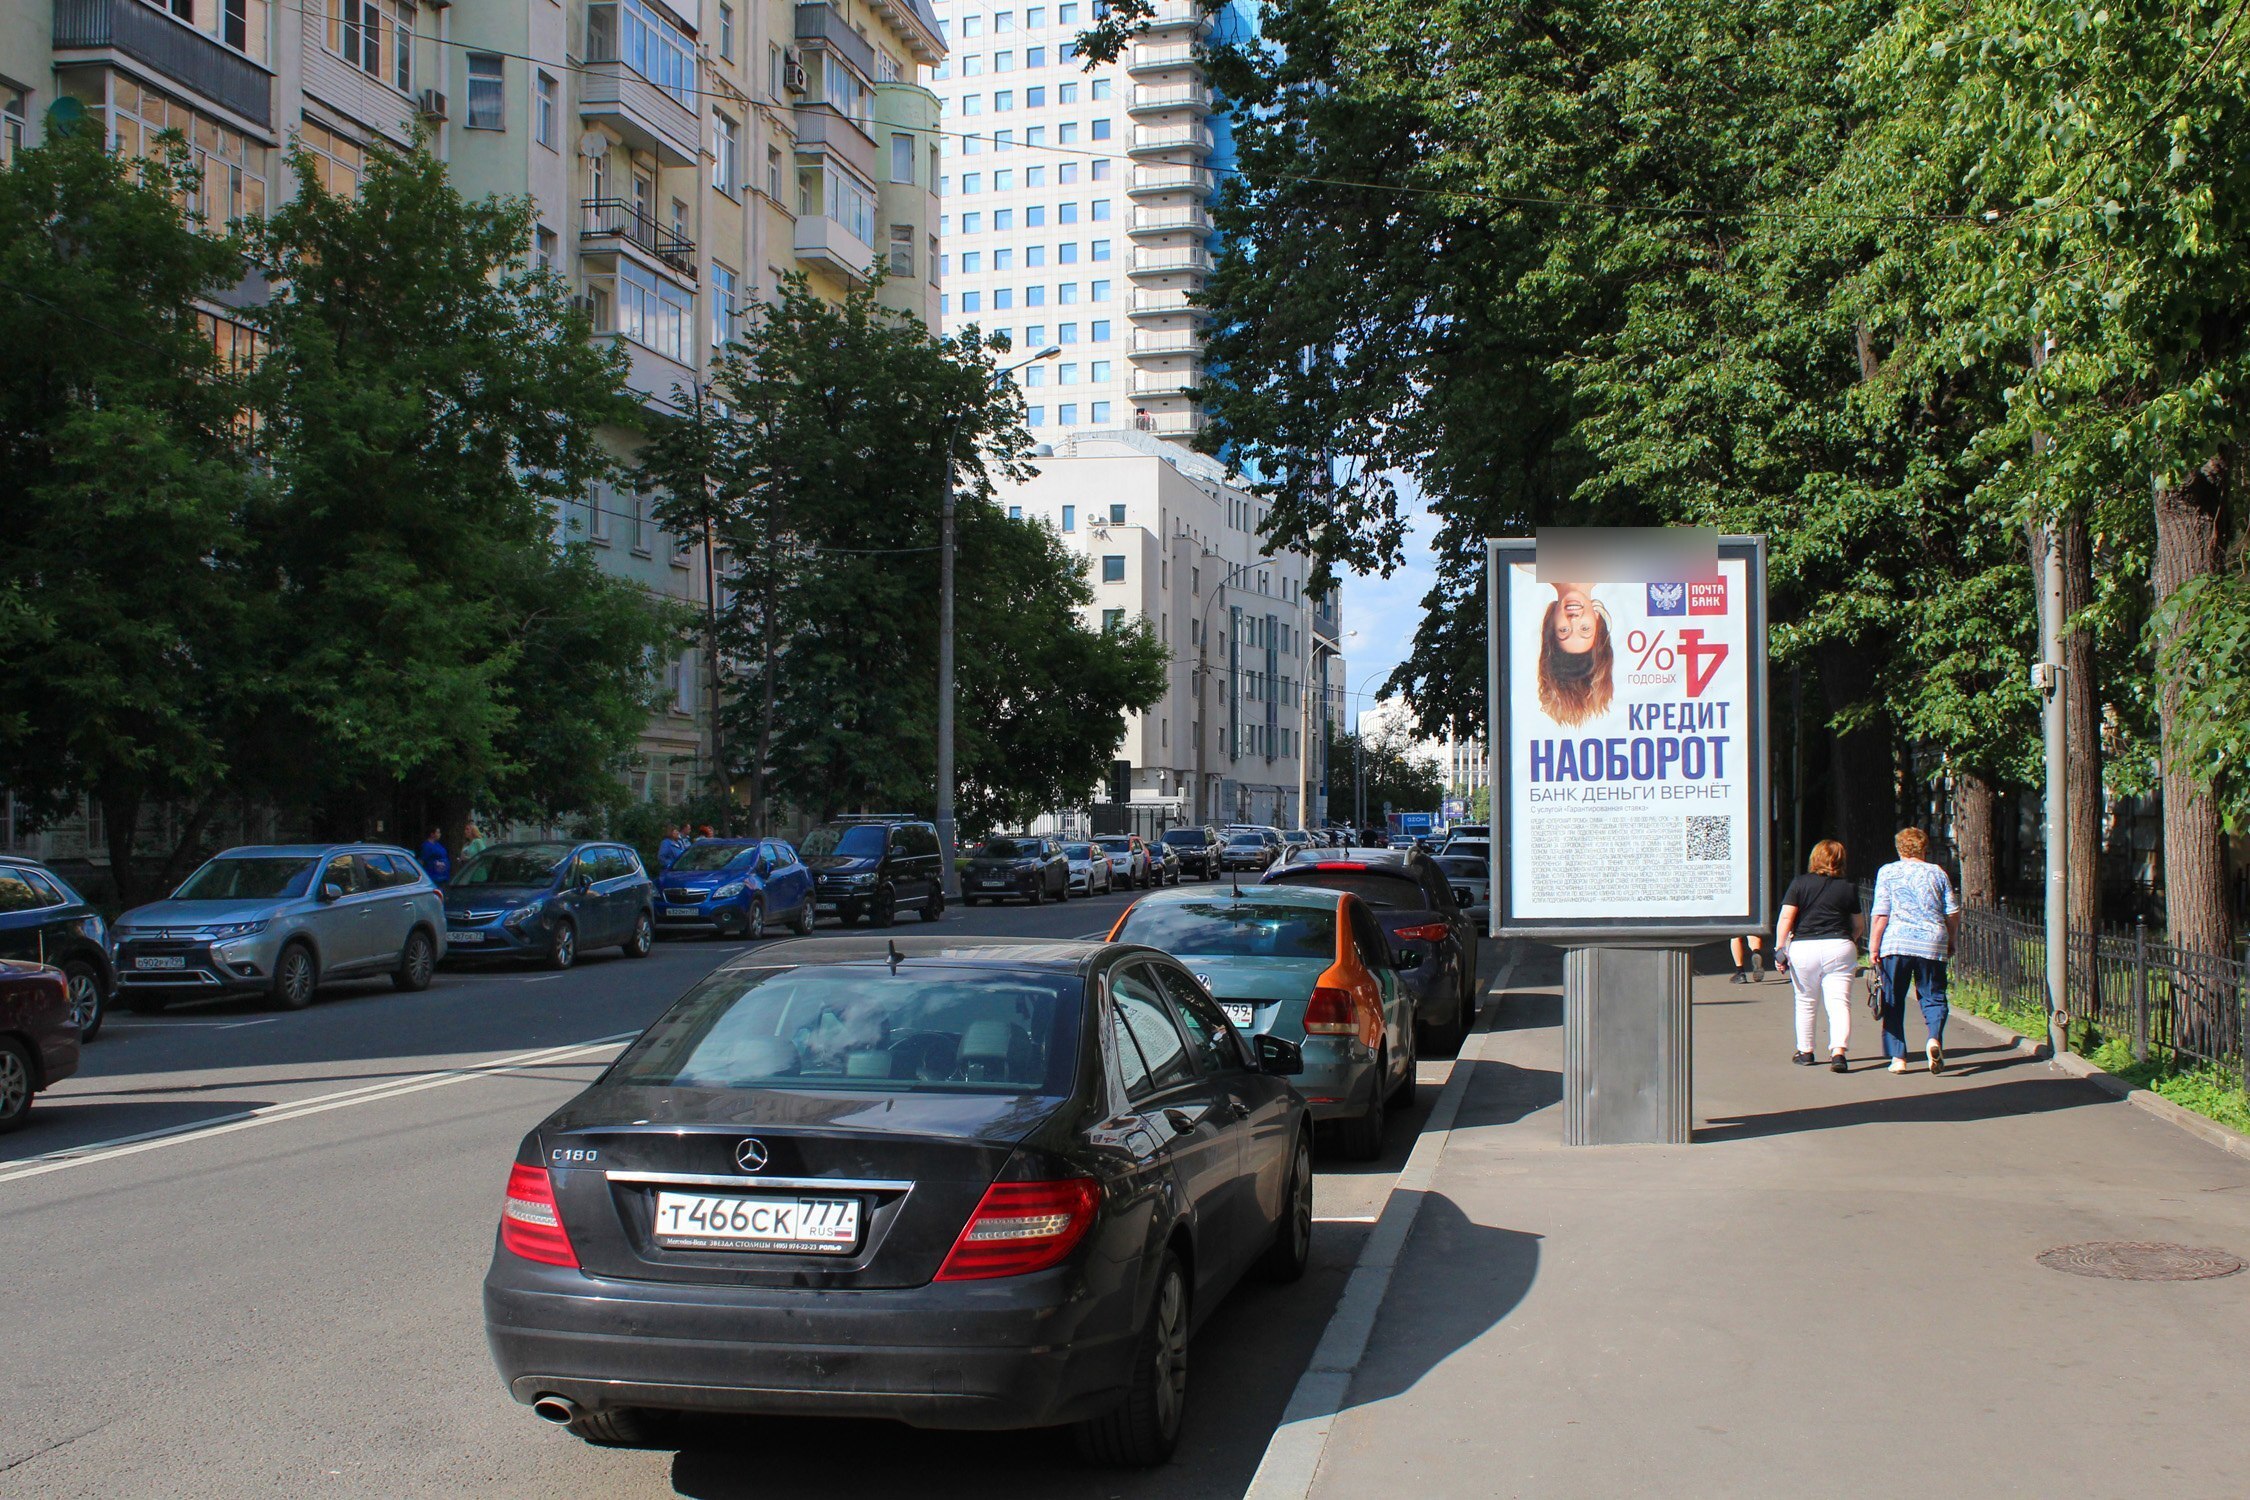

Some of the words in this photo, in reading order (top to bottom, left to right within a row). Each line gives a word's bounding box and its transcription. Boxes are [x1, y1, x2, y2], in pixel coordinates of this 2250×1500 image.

[1691, 584, 1725, 595] ПОЧТА
[1691, 596, 1721, 607] БАНК
[1628, 702, 1730, 733] КРЕДИТ
[1530, 736, 1730, 782] НАОБОРОТ
[1530, 787, 1578, 802] БАНК
[1581, 786, 1655, 803] ДЕНЬГИ
[1661, 782, 1731, 800] ВЕРНЁТ
[1537, 805, 1562, 814] услугой
[1224, 1004, 1248, 1016] 799
[669, 1199, 792, 1234] Т466СК
[800, 1199, 849, 1226] 777
[809, 1226, 834, 1236] RUS
[666, 1238, 707, 1246] Mercedes-Benz
[709, 1240, 734, 1248] ЗВЕЗДА
[735, 1241, 771, 1249] СТОЛИЦЫ
